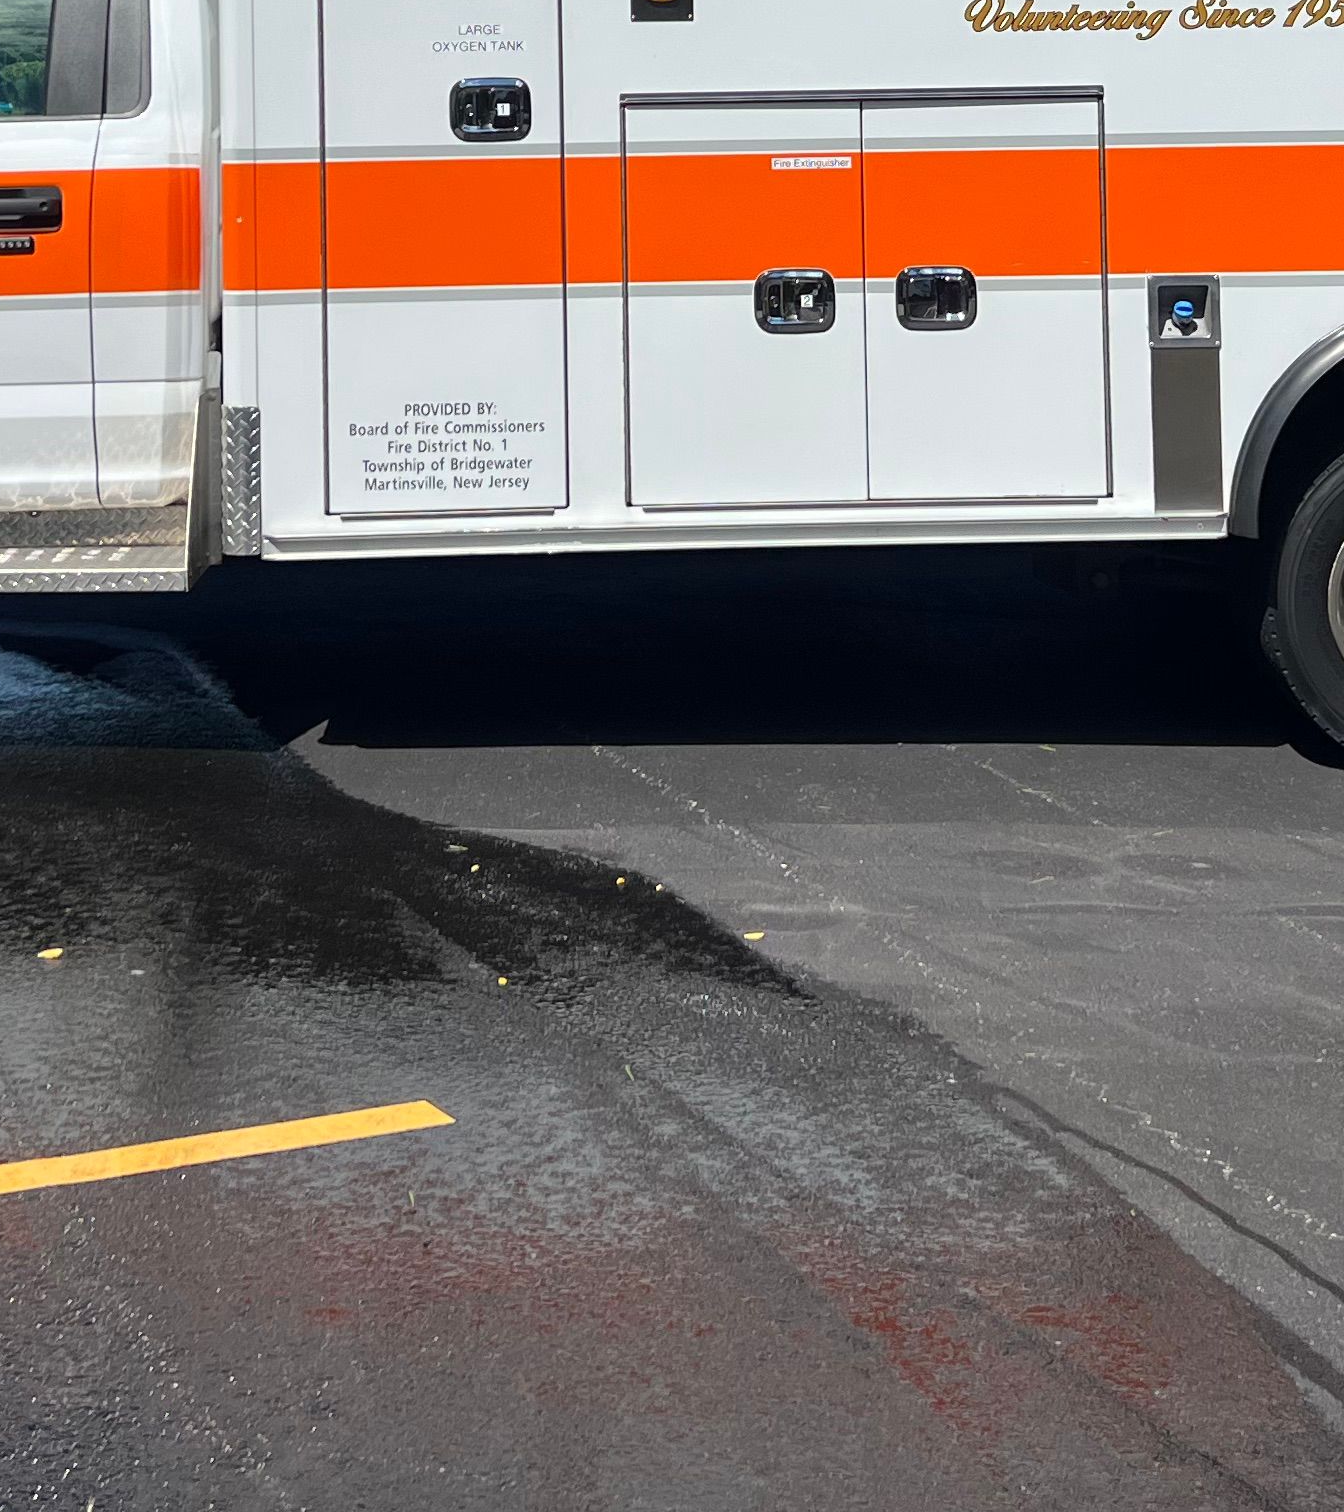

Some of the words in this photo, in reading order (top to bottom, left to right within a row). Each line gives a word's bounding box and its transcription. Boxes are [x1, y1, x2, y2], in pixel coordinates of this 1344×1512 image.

[457, 24, 501, 36] LARGE
[432, 41, 487, 53] OXYGEN
[490, 40, 524, 51] TANK
[773, 159, 792, 168] Fire
[793, 158, 850, 169] Extinguisher
[404, 403, 471, 417] PROVIDED
[477, 402, 497, 416] BY:
[349, 422, 389, 436] Board
[394, 422, 410, 436] of
[414, 421, 439, 436] Fire
[444, 420, 545, 434] Commissioners
[387, 441, 412, 454] Fire
[417, 439, 467, 454] District
[472, 439, 495, 452] No.
[501, 438, 508, 451] 1
[362, 459, 426, 475] Township
[430, 458, 445, 471] of
[450, 457, 533, 474] Bridgewater
[364, 476, 448, 492] Martinsville,
[453, 476, 484, 489] New
[488, 475, 530, 491] Jersey
